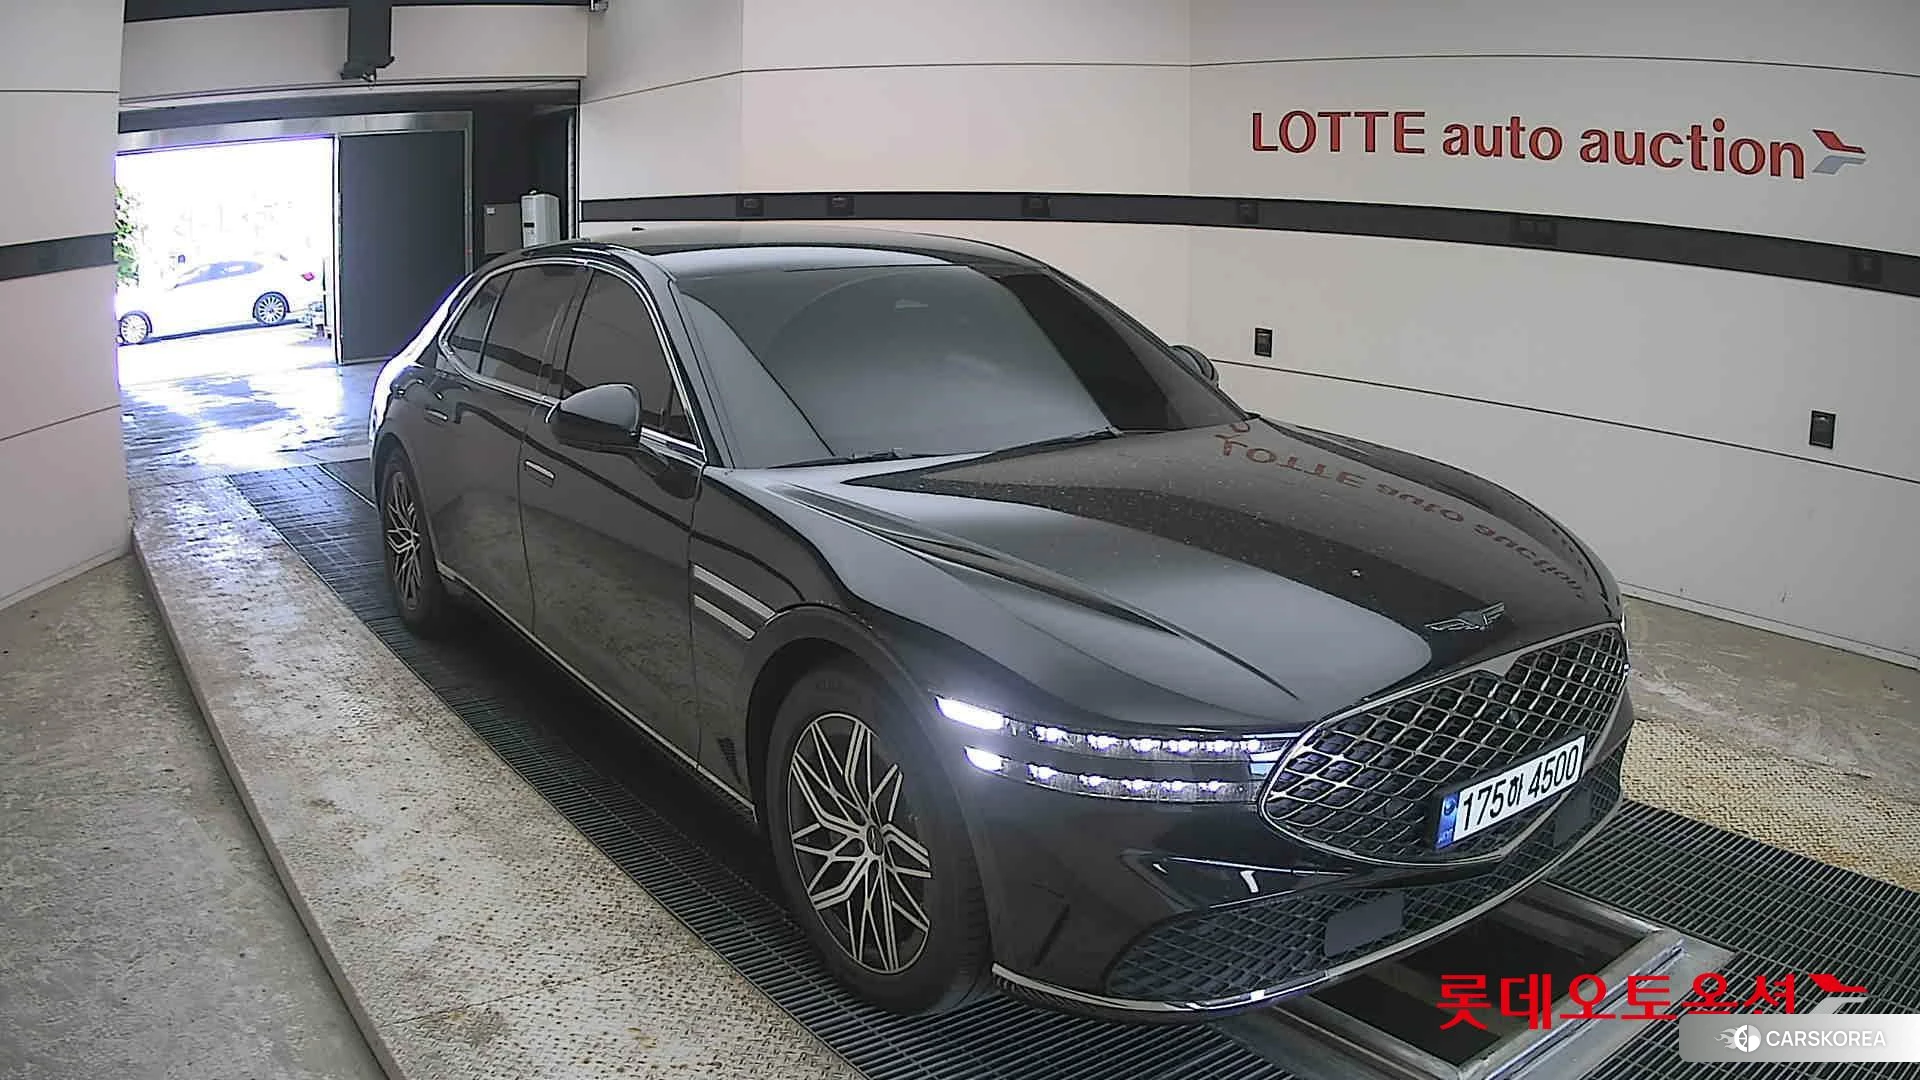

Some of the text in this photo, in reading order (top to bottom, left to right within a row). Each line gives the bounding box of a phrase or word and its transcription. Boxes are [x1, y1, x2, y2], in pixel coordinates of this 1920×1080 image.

[1253, 112, 1805, 179] LOTTE auto auction
[1528, 745, 1578, 798] 4500
